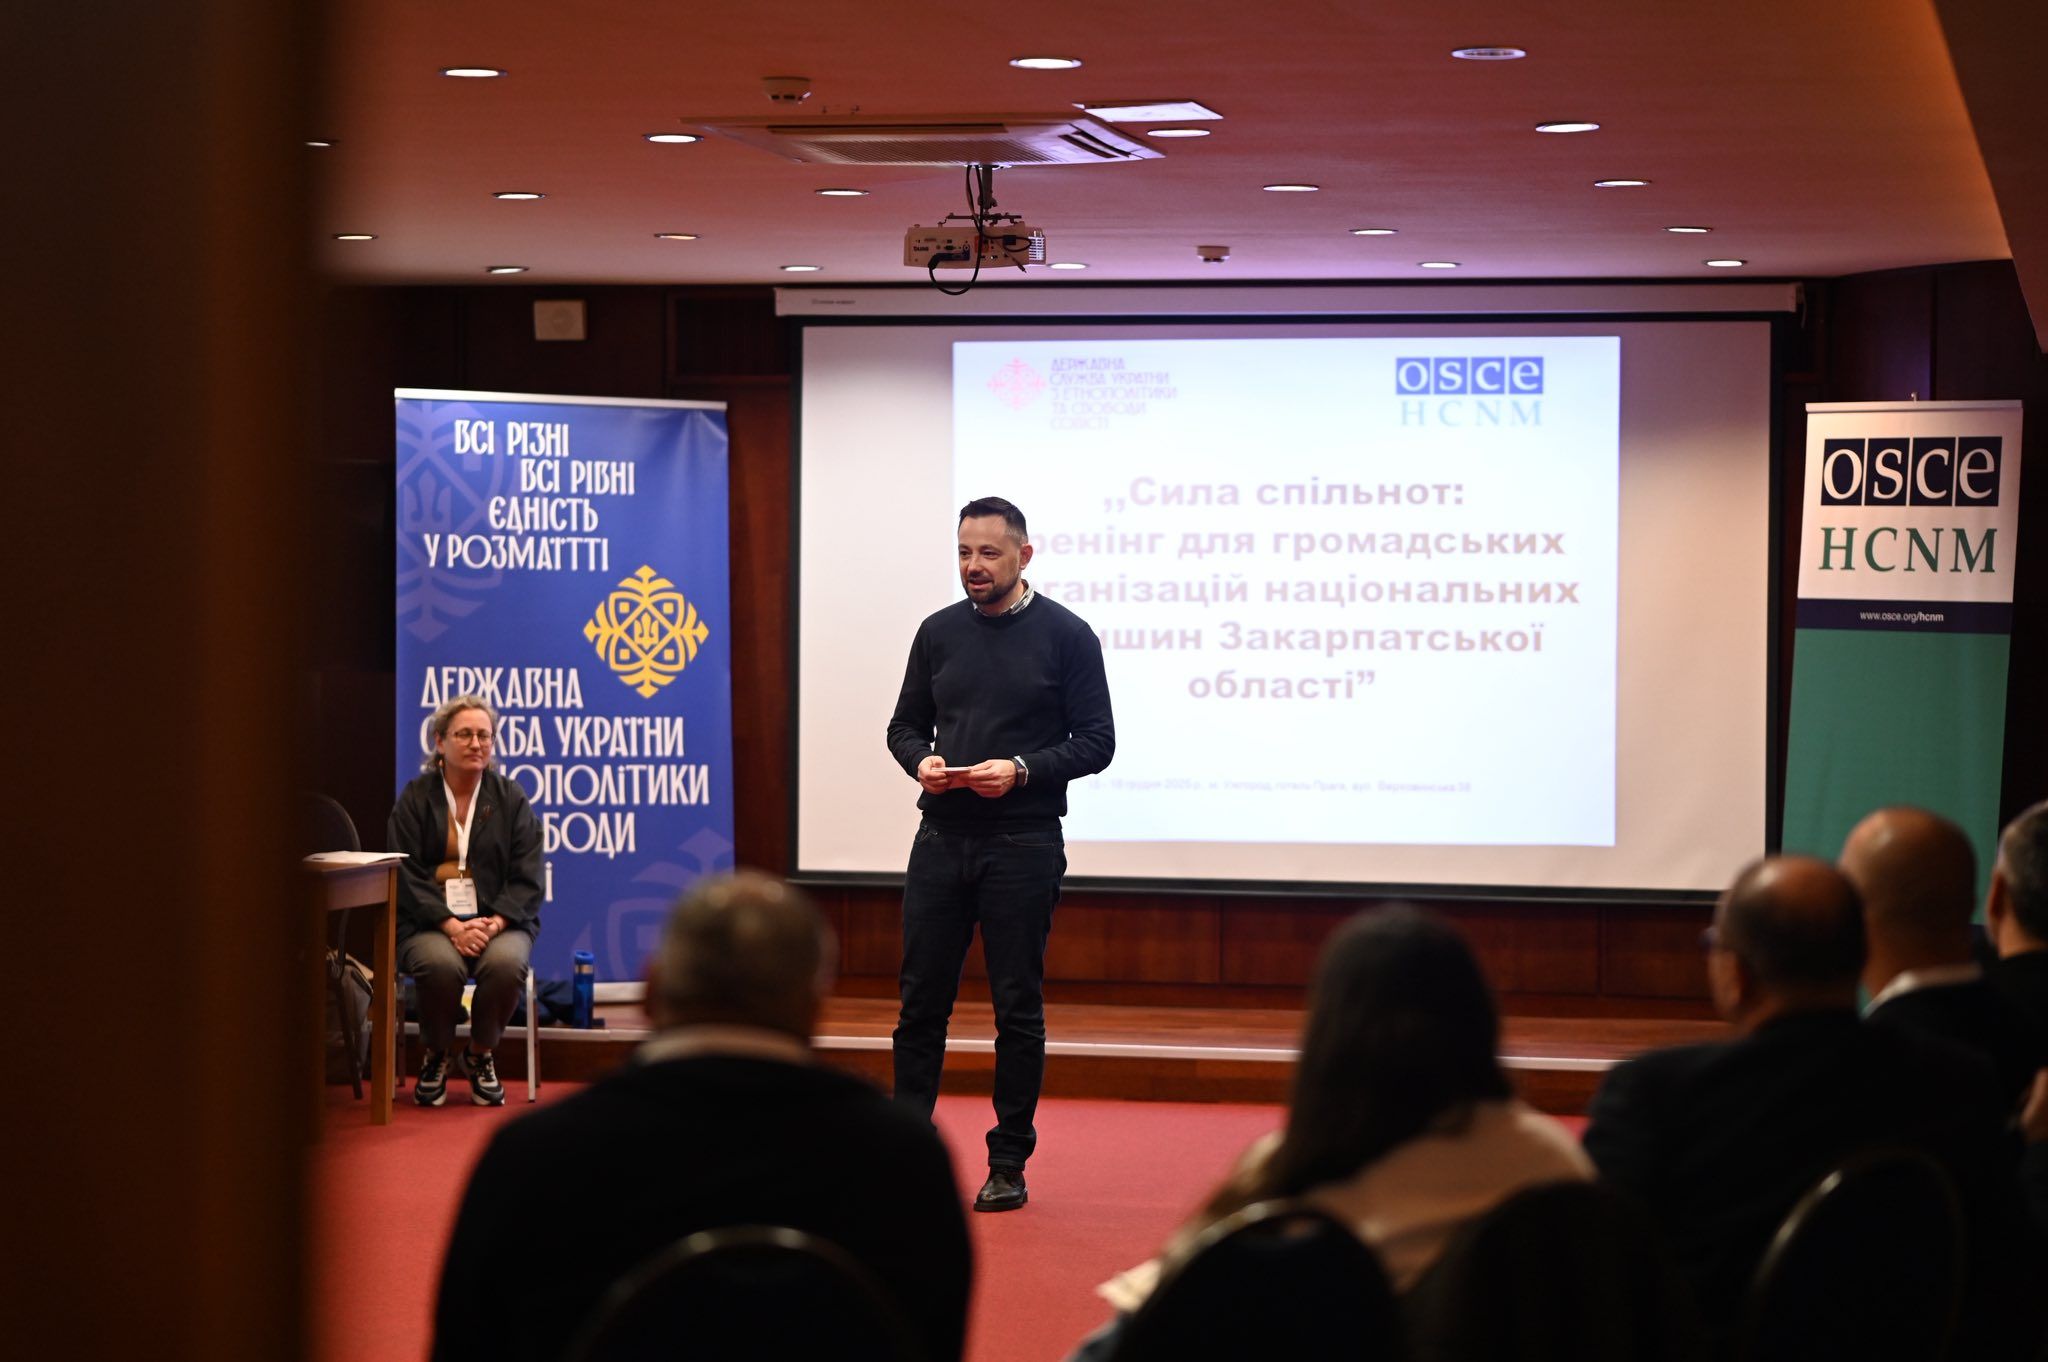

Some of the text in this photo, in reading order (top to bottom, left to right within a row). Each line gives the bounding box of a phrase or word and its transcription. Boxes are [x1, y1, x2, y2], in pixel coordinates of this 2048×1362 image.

[1401, 400, 1543, 427] HCNM
[454, 420, 569, 457] ВСІ РІЗНІ
[521, 459, 635, 495] ВСІ РІВНІ
[1256, 476, 1464, 506] спільнот:
[489, 496, 598, 534] ЄДНІСТЬ
[424, 533, 609, 571] У РОЗМАЇТТІ
[1030, 525, 1566, 561] ренінг для громадських
[1818, 527, 1998, 573] HCNM
[1042, 573, 1580, 608] ганізацій національних
[1859, 611, 1944, 624] www.osce.org/hcnm
[1219, 620, 1545, 658] Закарпатської
[554, 716, 684, 757] УКРАЇНИ
